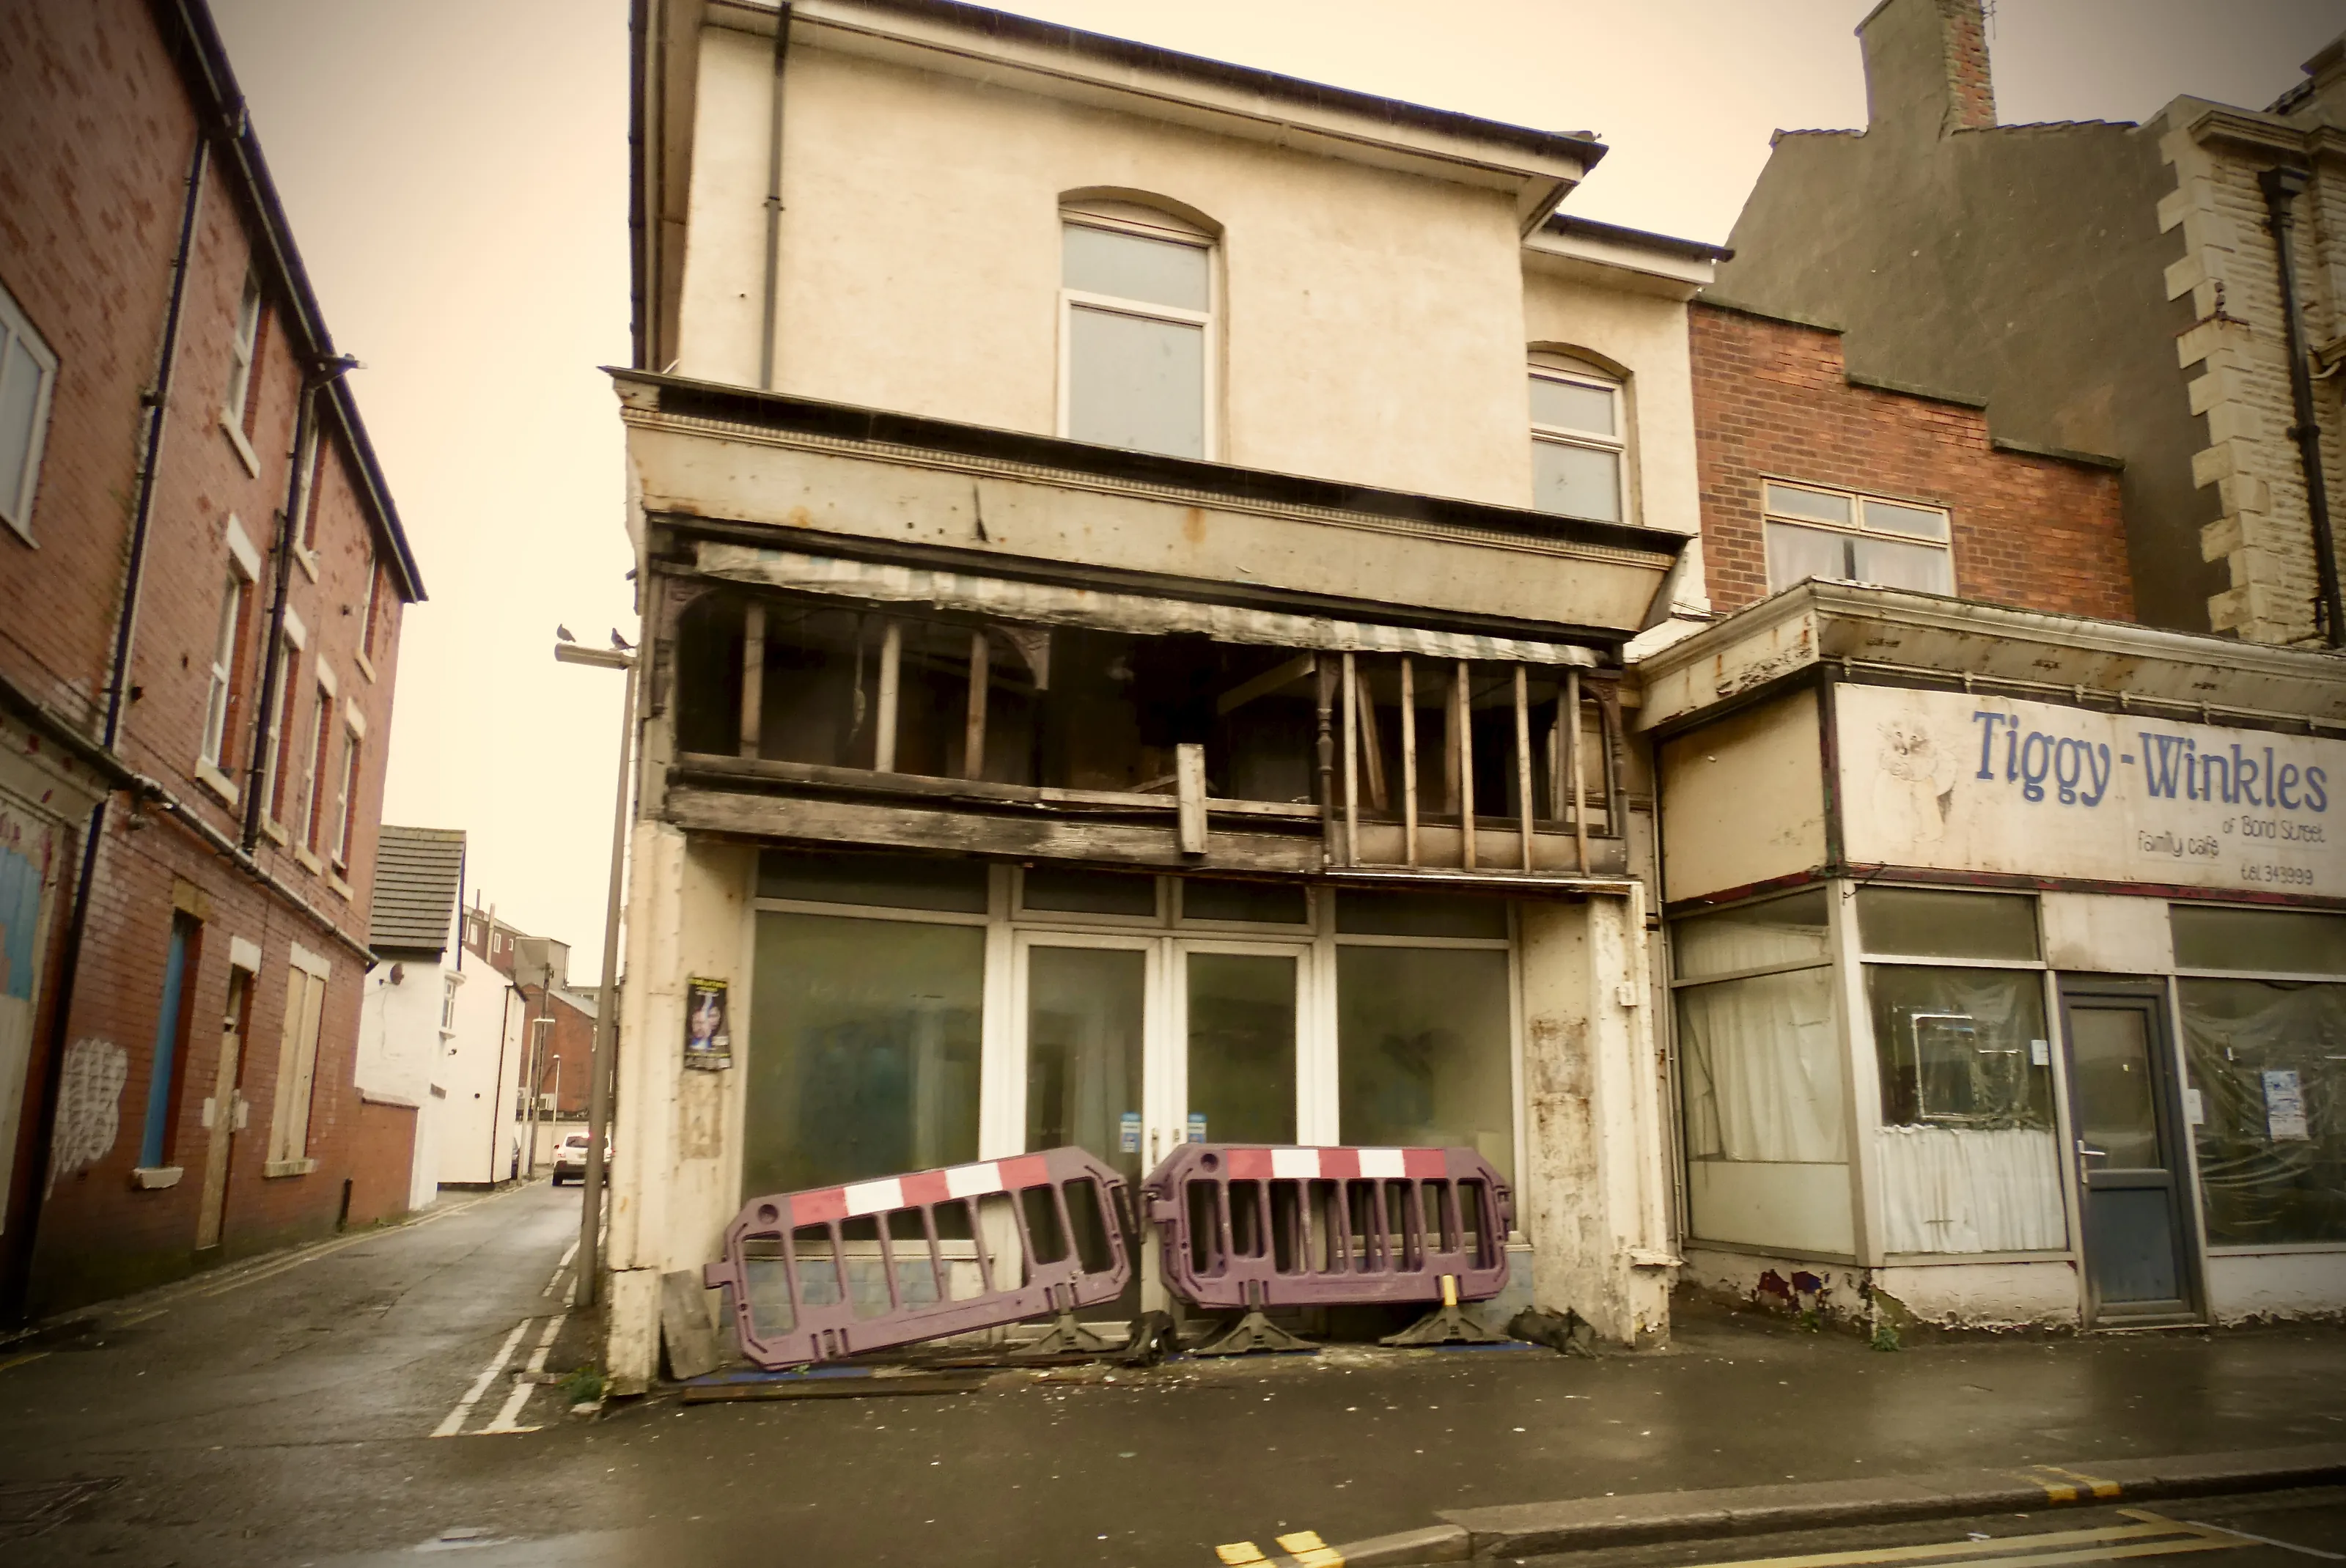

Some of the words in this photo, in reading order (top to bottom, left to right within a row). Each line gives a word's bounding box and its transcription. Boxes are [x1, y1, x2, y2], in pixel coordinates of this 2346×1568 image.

[1973, 711, 2328, 812] Tiggy-Winkles
[2241, 815, 2276, 839] Bond
[2281, 820, 2325, 842] Street
[2241, 863, 2262, 880] tel
